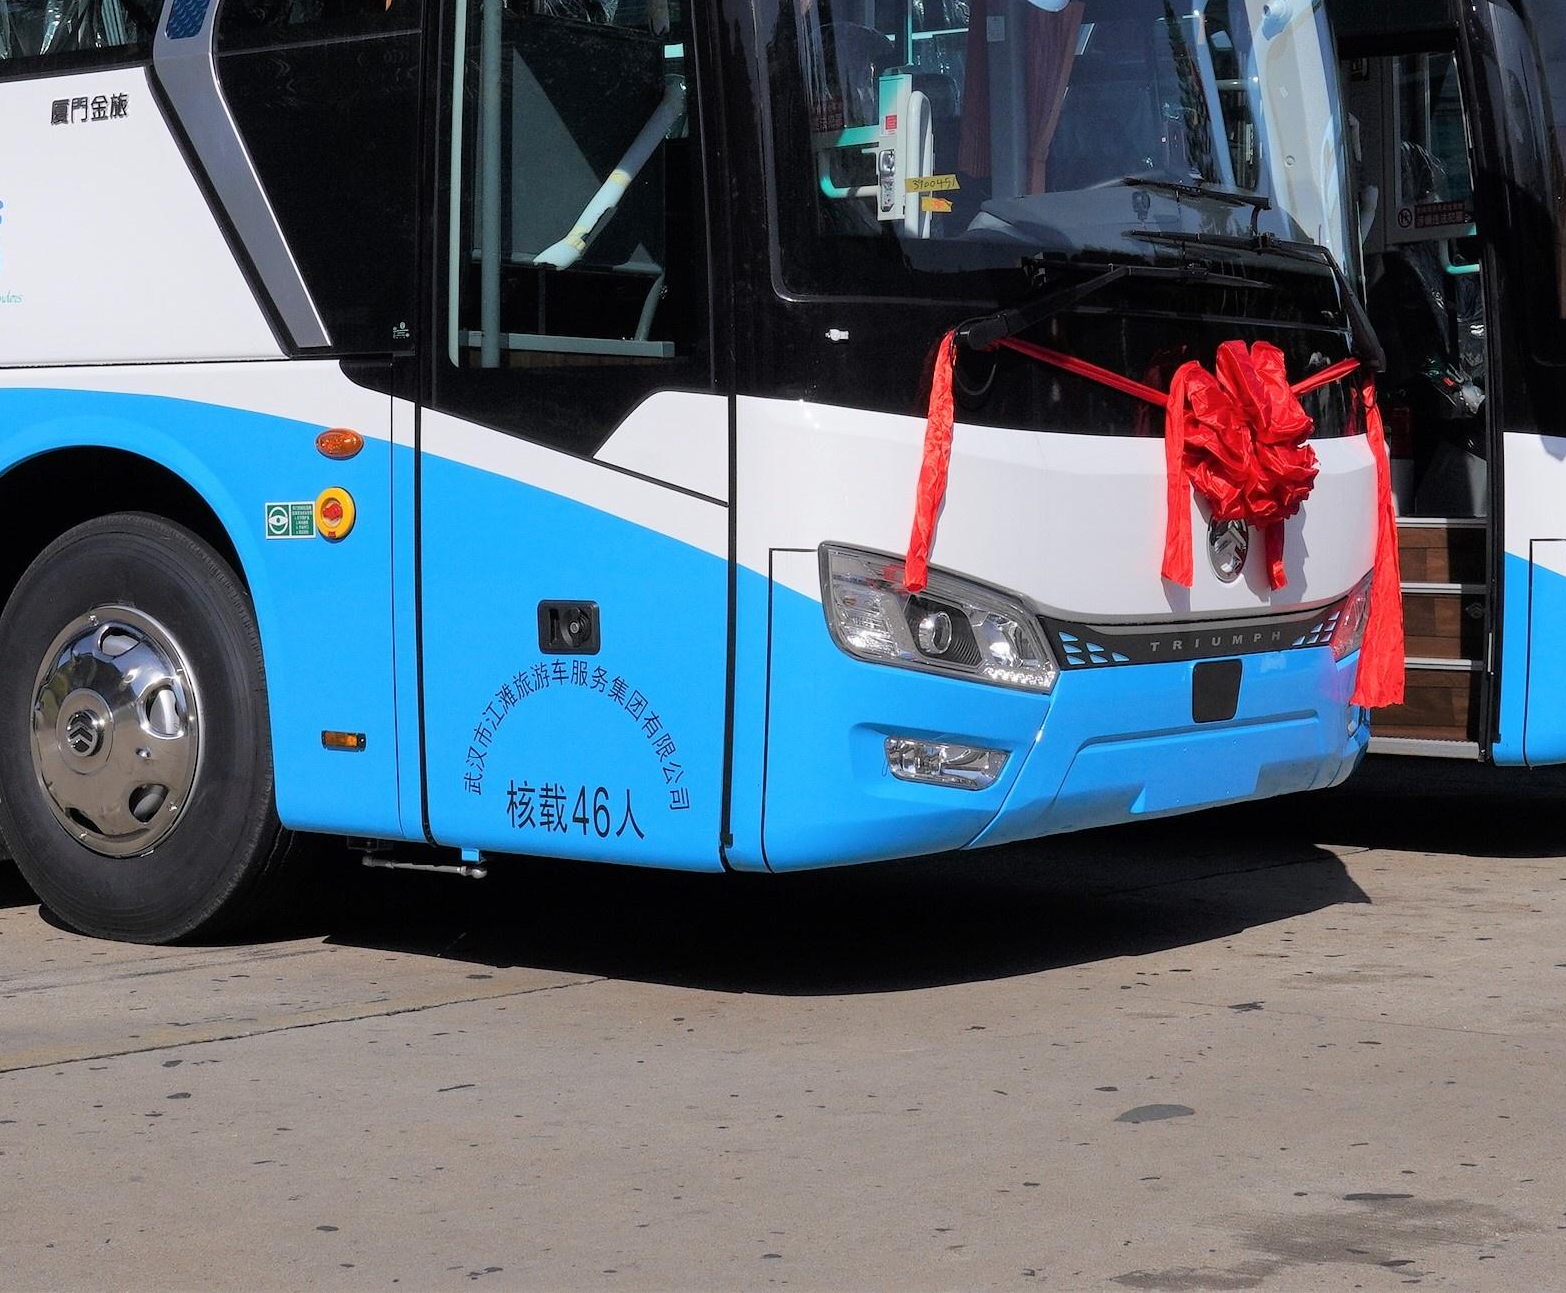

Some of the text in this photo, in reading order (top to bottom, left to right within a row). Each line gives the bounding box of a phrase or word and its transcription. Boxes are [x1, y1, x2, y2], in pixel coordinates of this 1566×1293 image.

[1149, 630, 1281, 652] TRIUMPH
[464, 658, 690, 811] 武汉市江滩旅游车服务集团有限公司
[506, 779, 645, 840] 核载46人
